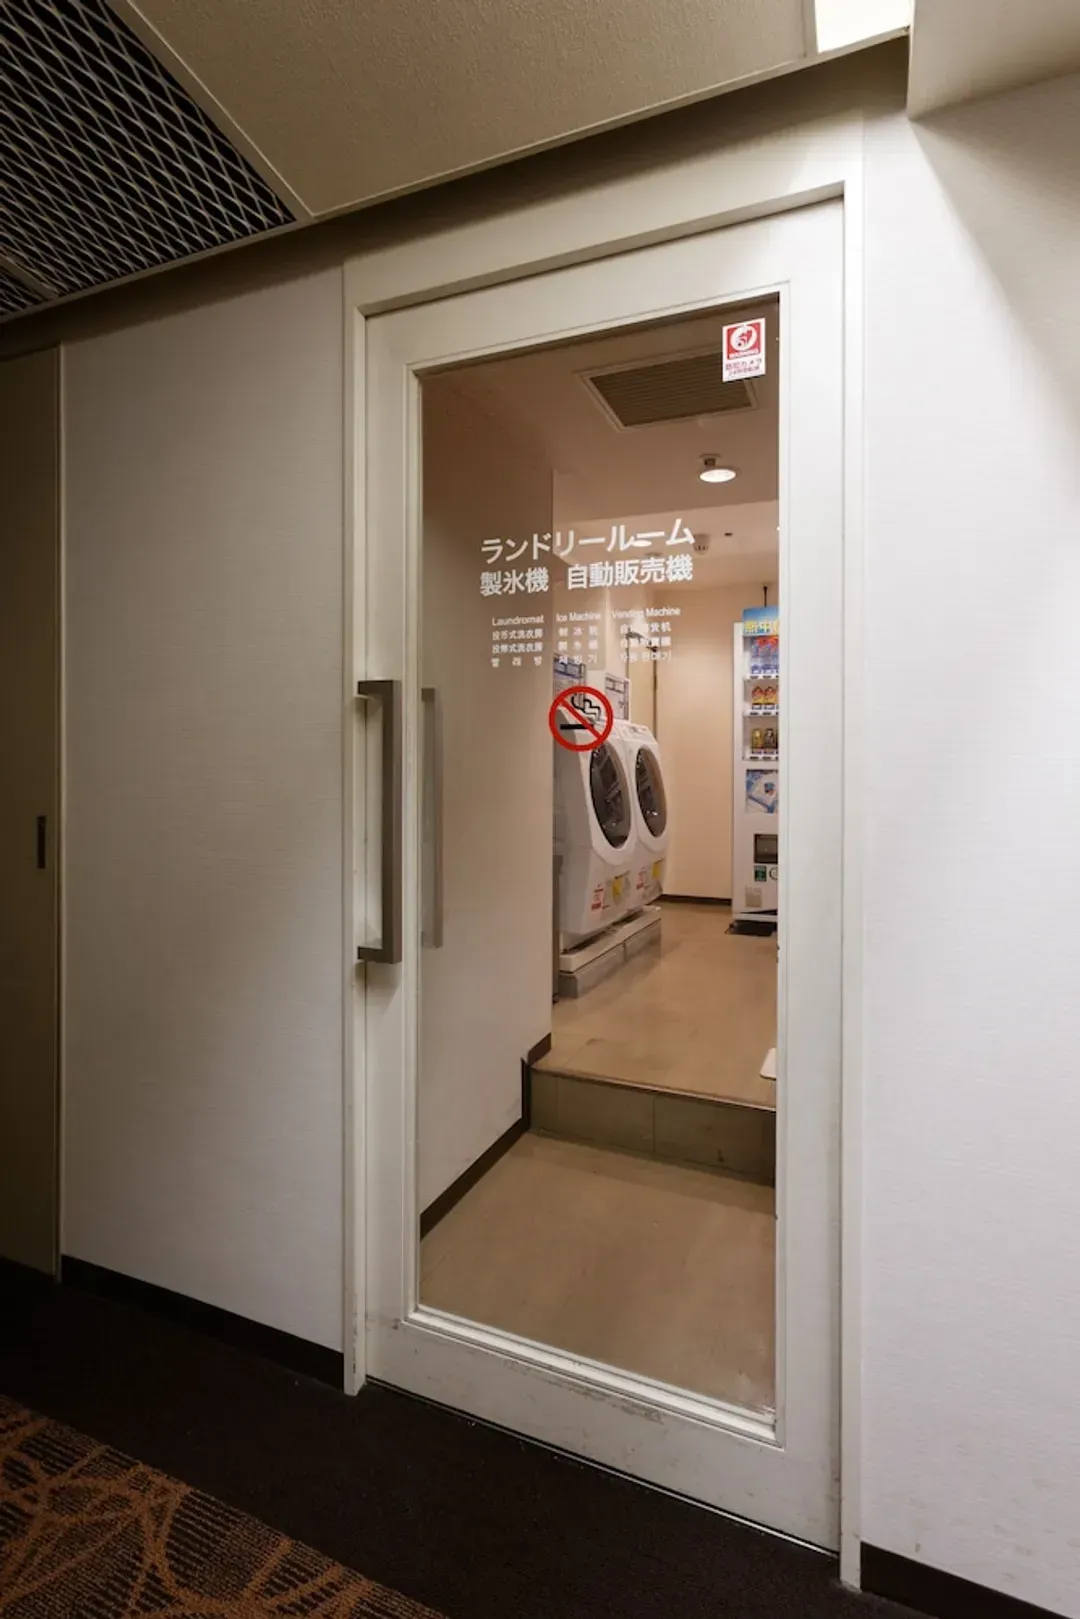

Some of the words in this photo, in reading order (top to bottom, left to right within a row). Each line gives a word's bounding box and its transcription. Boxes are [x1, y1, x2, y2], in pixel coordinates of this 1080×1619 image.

[481, 518, 696, 565] ランドリールーム
[480, 566, 549, 597] 製氷機
[567, 553, 694, 590] 自動販売機
[556, 612, 568, 624] Ice
[569, 610, 602, 622] Machine
[646, 606, 681, 618] Machine
[492, 613, 545, 627] Laundromat
